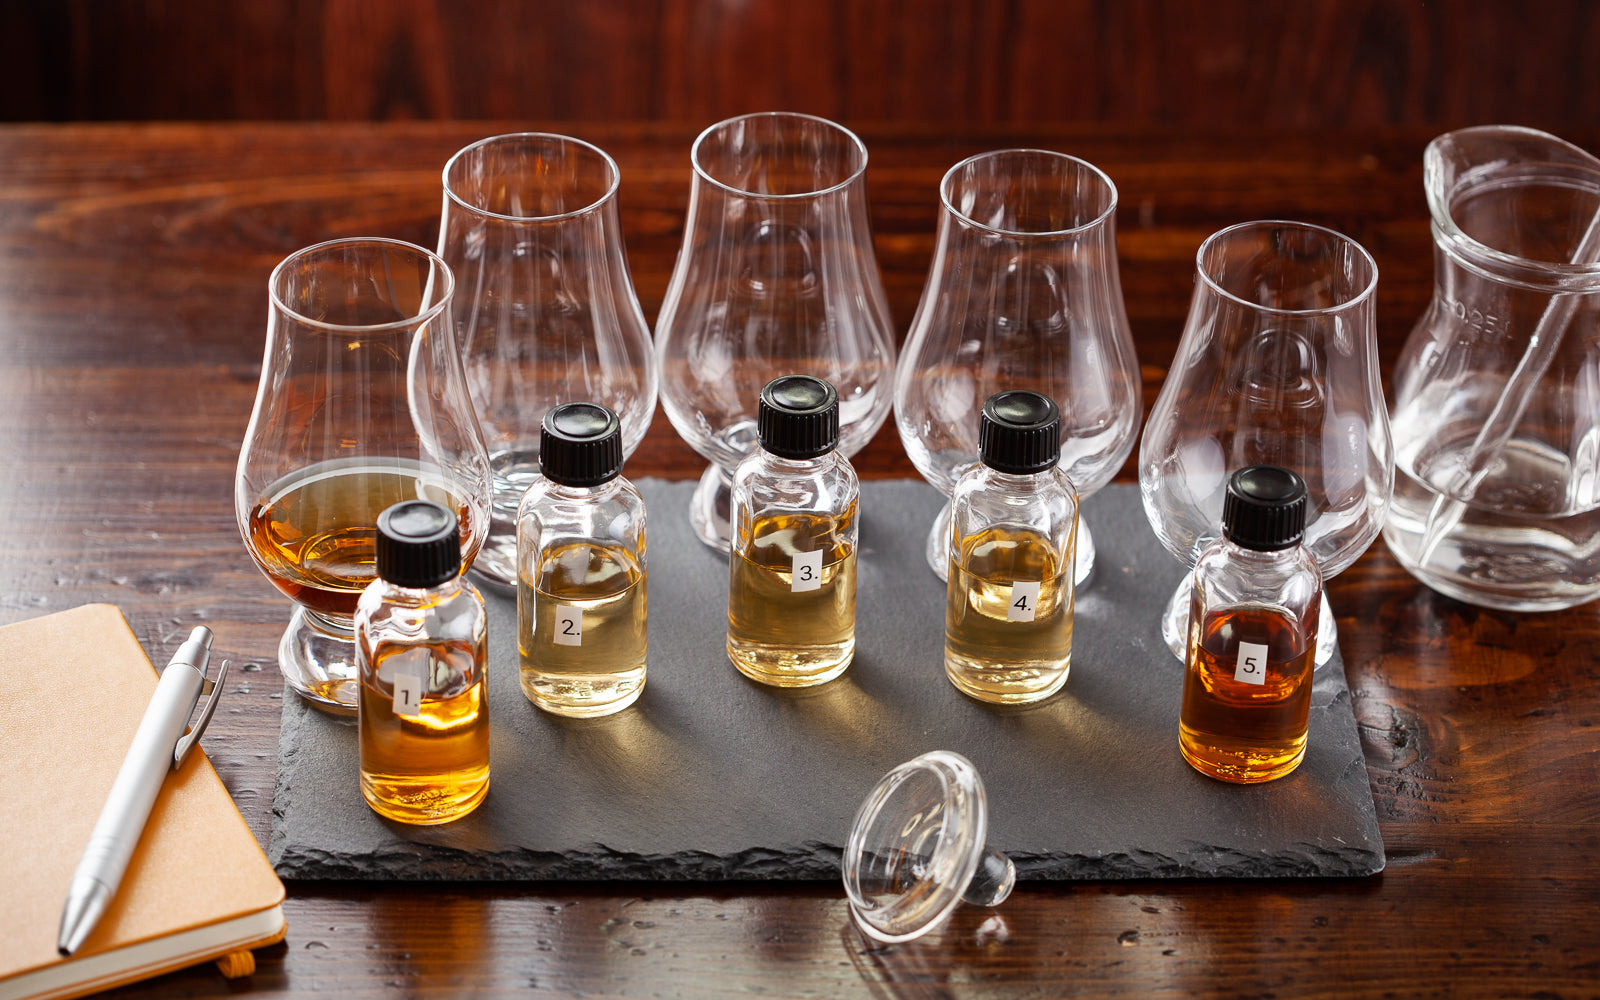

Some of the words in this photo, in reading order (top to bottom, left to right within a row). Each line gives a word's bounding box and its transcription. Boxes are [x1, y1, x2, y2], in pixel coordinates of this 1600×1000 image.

[799, 565, 820, 582] 3.
[1013, 595, 1033, 611] 4.
[561, 618, 582, 637] 2.
[1242, 656, 1261, 675] 5.
[401, 689, 418, 707] 1.
